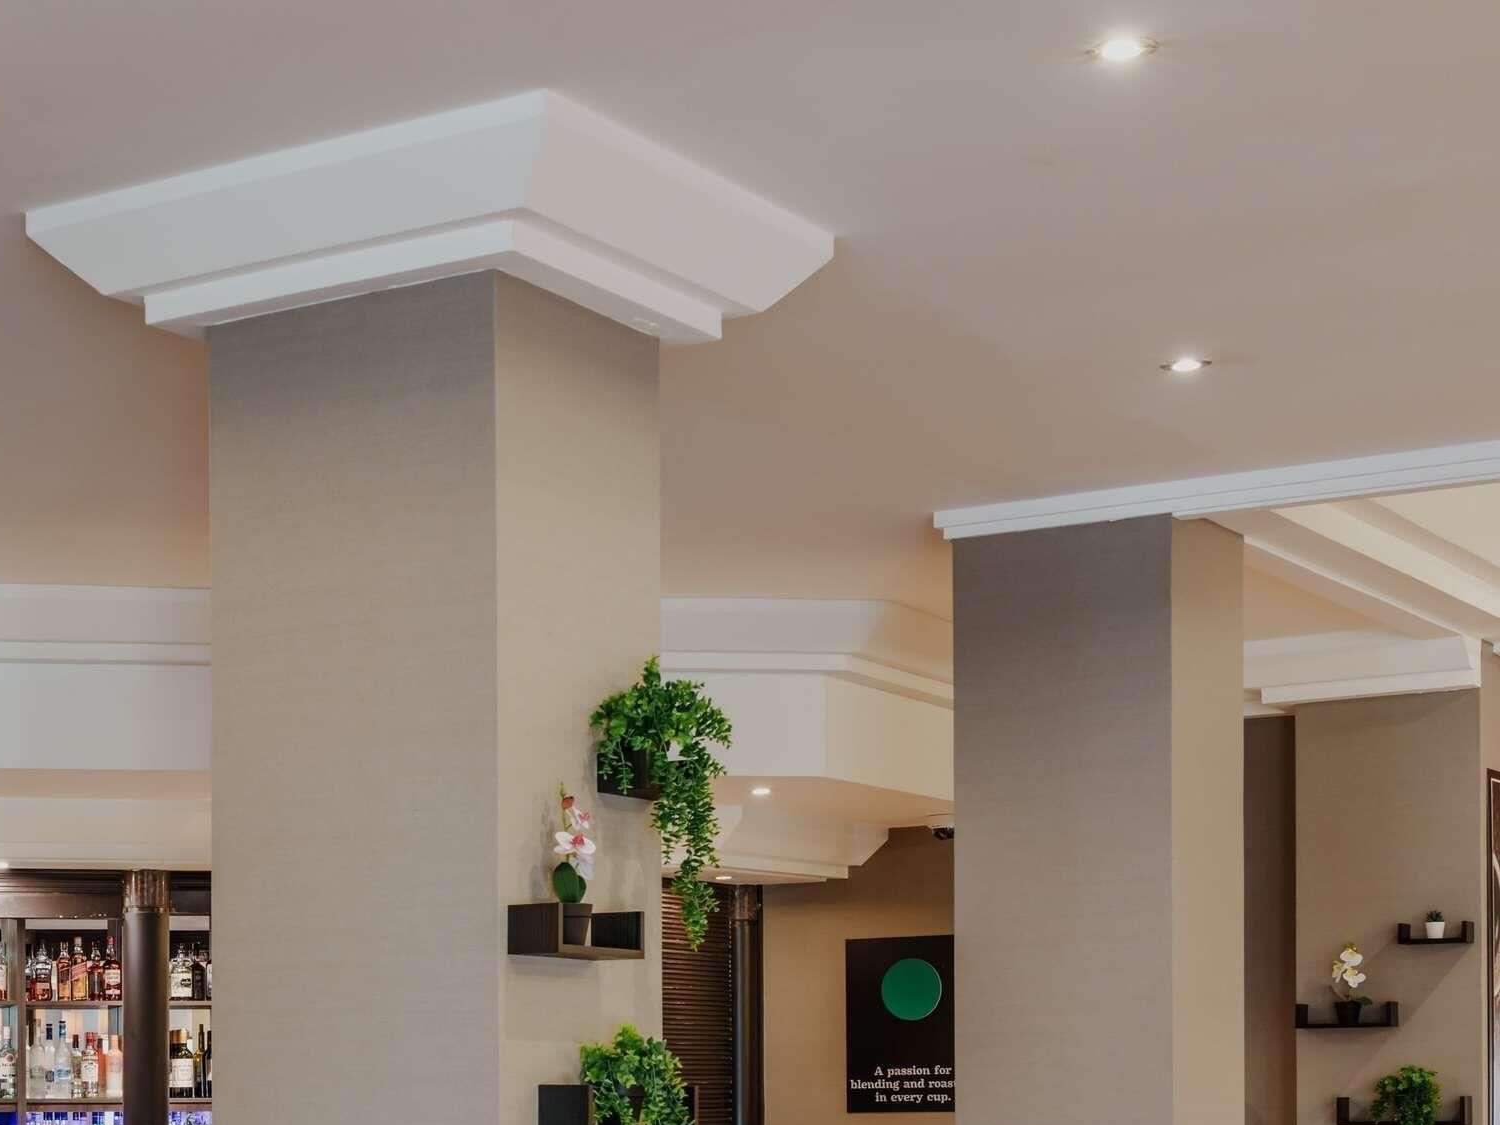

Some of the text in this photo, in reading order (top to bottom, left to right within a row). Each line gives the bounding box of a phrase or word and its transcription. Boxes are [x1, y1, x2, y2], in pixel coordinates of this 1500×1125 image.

[874, 1064, 952, 1078] A passion for
[850, 1079, 900, 1092] blending
[903, 1078, 925, 1089] and
[875, 1091, 951, 1104] in every cup.
